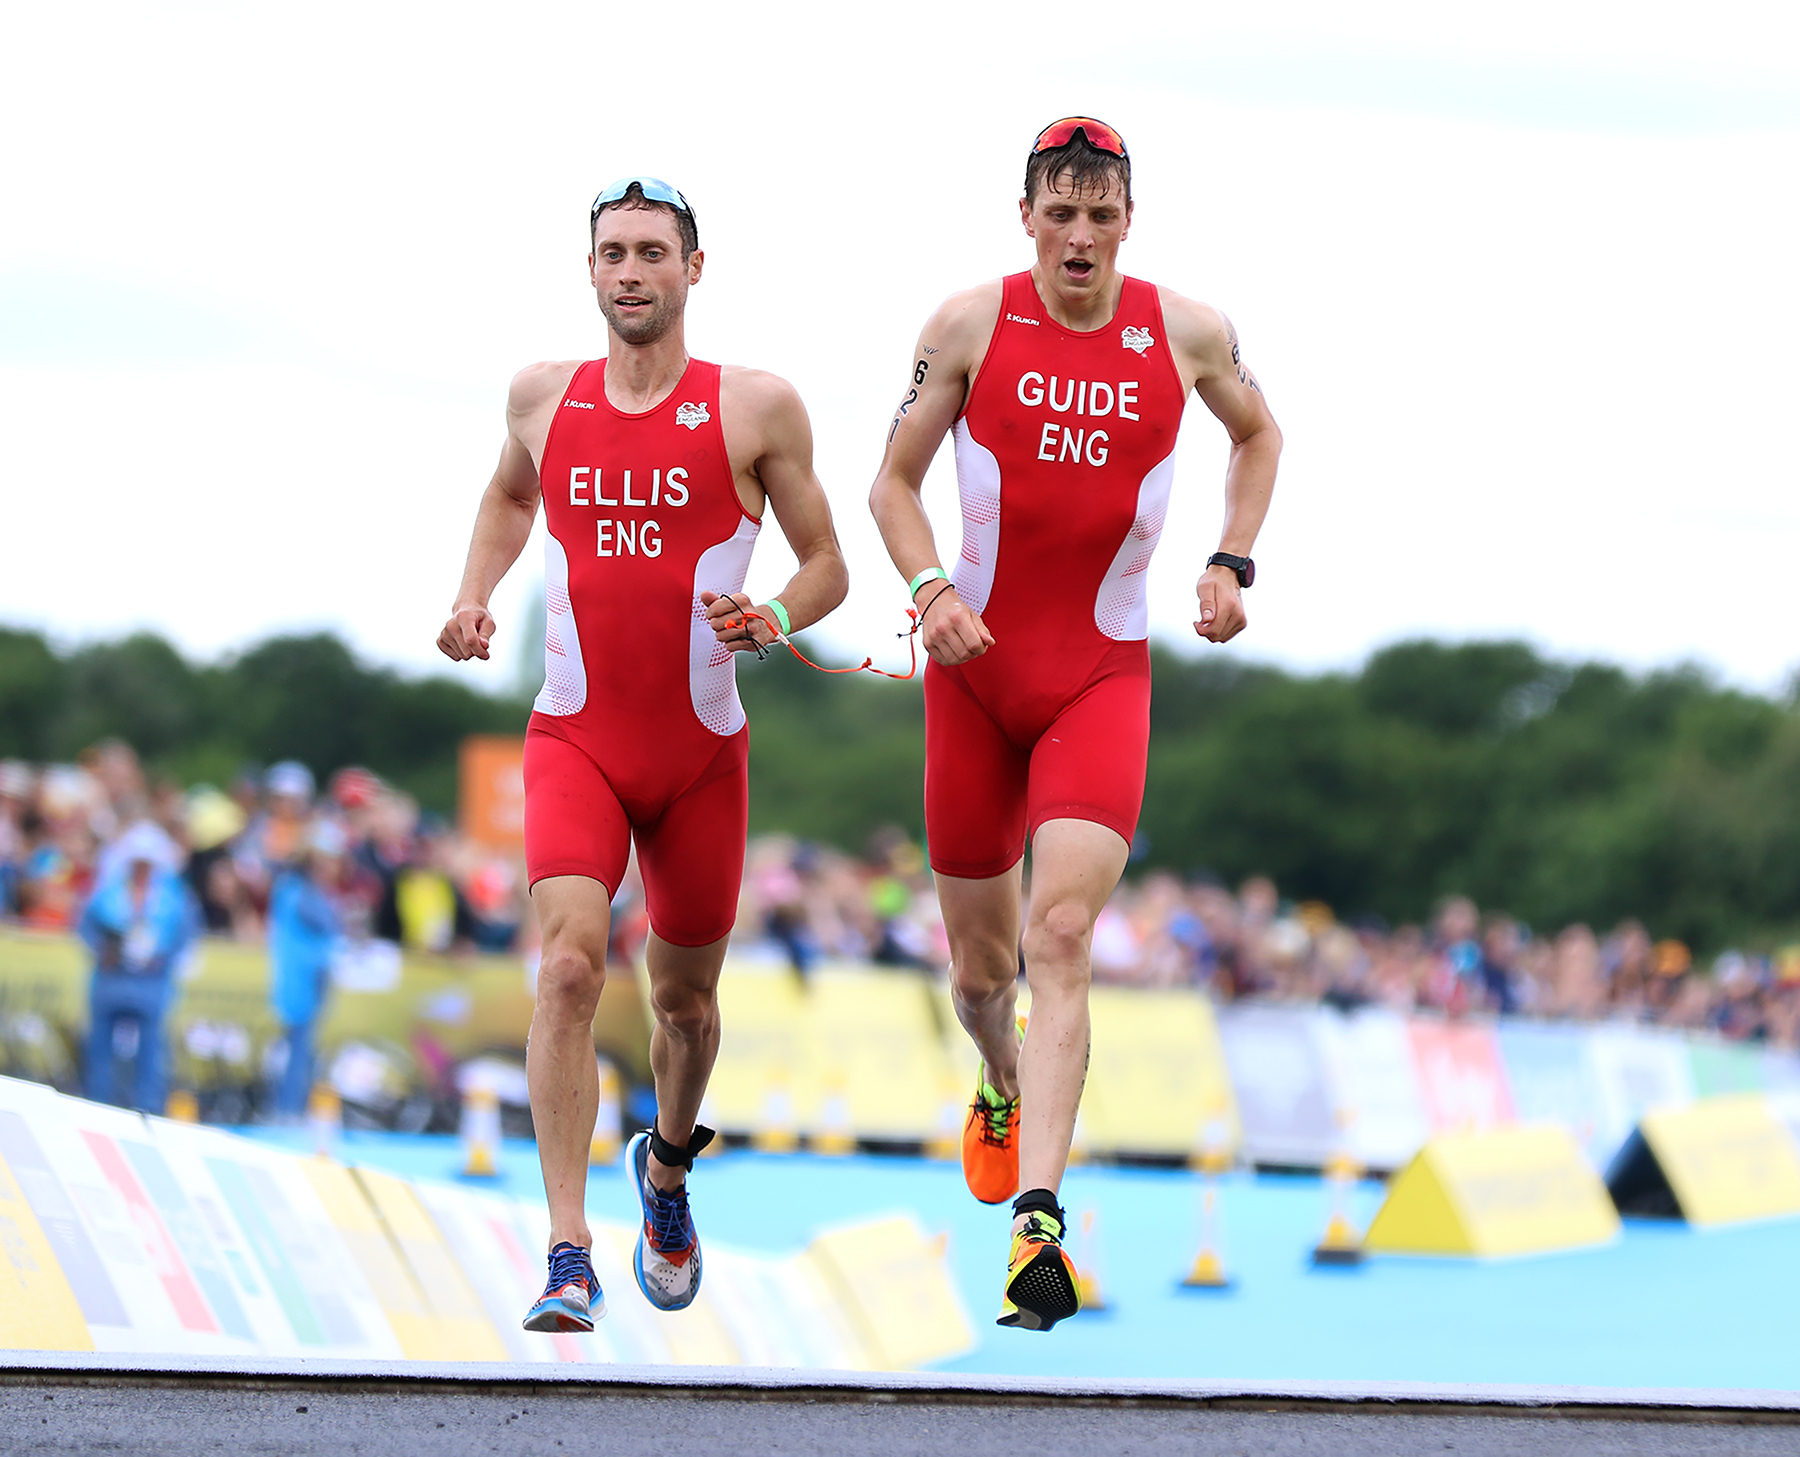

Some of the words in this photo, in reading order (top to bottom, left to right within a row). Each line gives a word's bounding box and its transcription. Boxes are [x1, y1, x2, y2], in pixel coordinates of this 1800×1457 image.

[1012, 314, 1040, 326] KUKRI
[569, 400, 596, 410] KUKRI
[888, 359, 929, 443] 621
[1017, 371, 1141, 422] GUIDE
[1037, 422, 1110, 467] ENG
[569, 466, 690, 507] ELLIS
[596, 519, 663, 558] ENG
